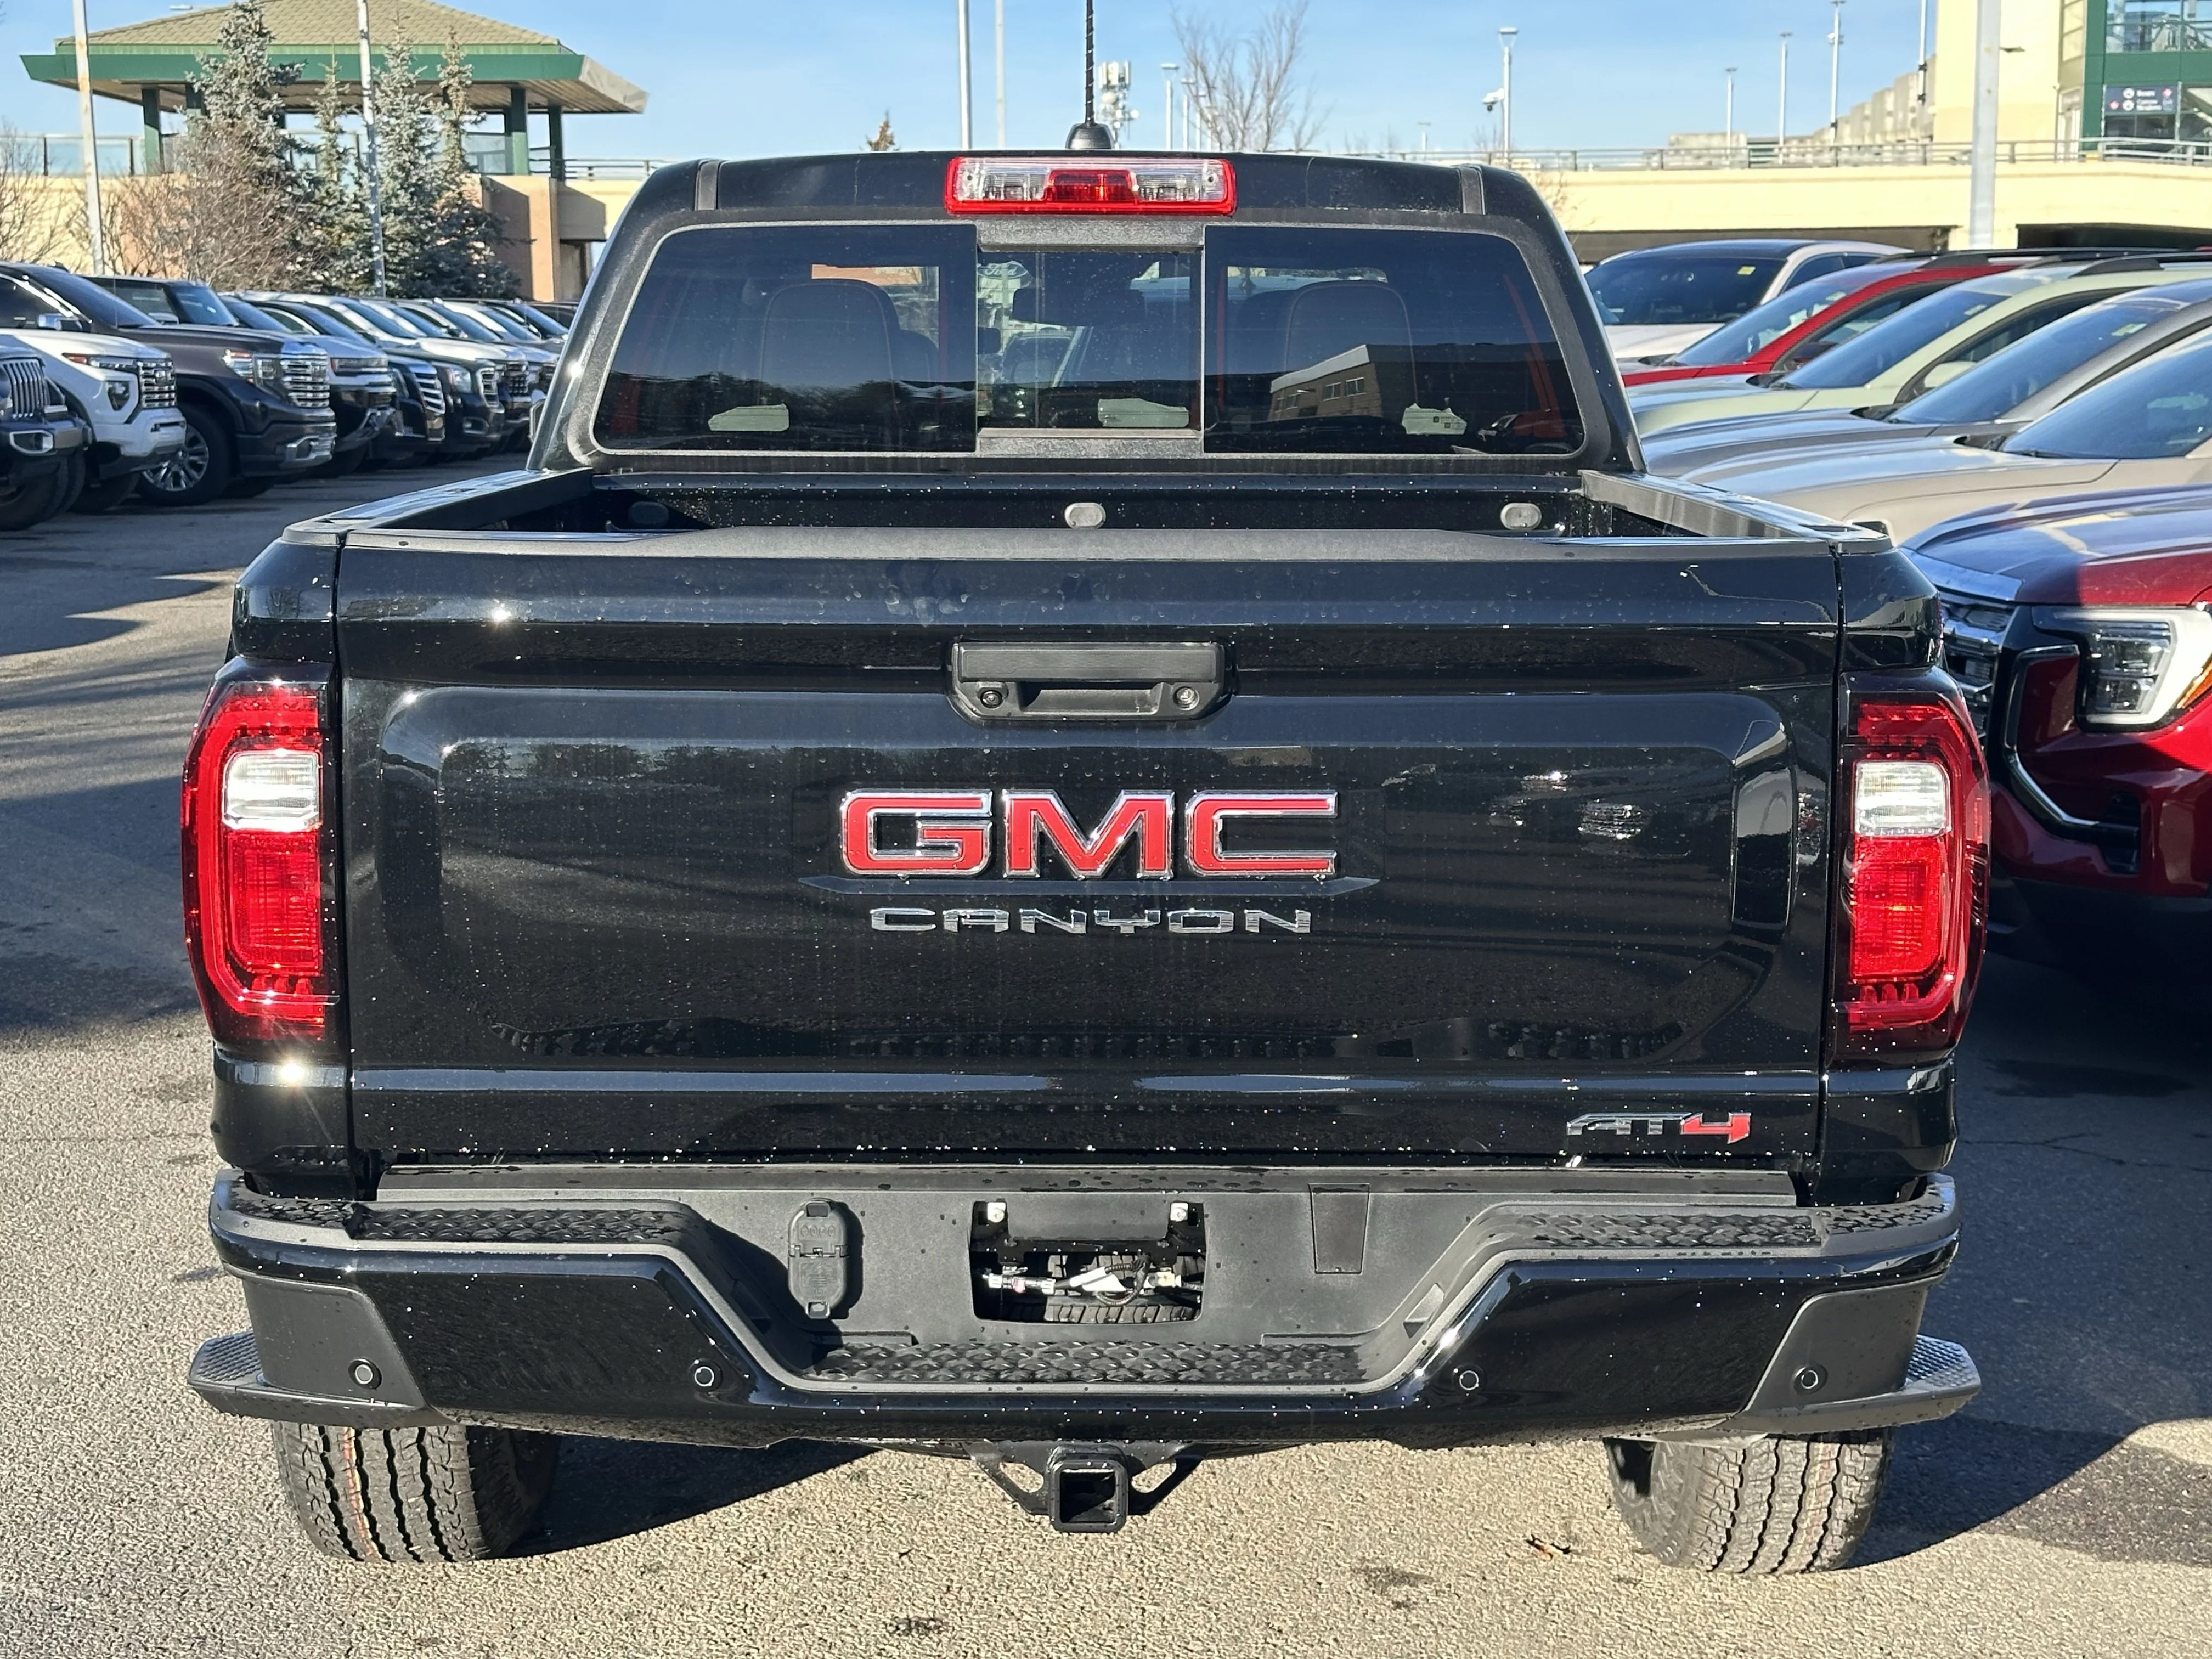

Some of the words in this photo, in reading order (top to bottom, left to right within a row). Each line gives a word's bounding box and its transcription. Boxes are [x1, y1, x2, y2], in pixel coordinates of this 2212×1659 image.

[984, 263, 1018, 275] Fod
[840, 789, 1338, 879] GMC
[870, 908, 1312, 934] CANYON
[1566, 1111, 1751, 1144] AT4
